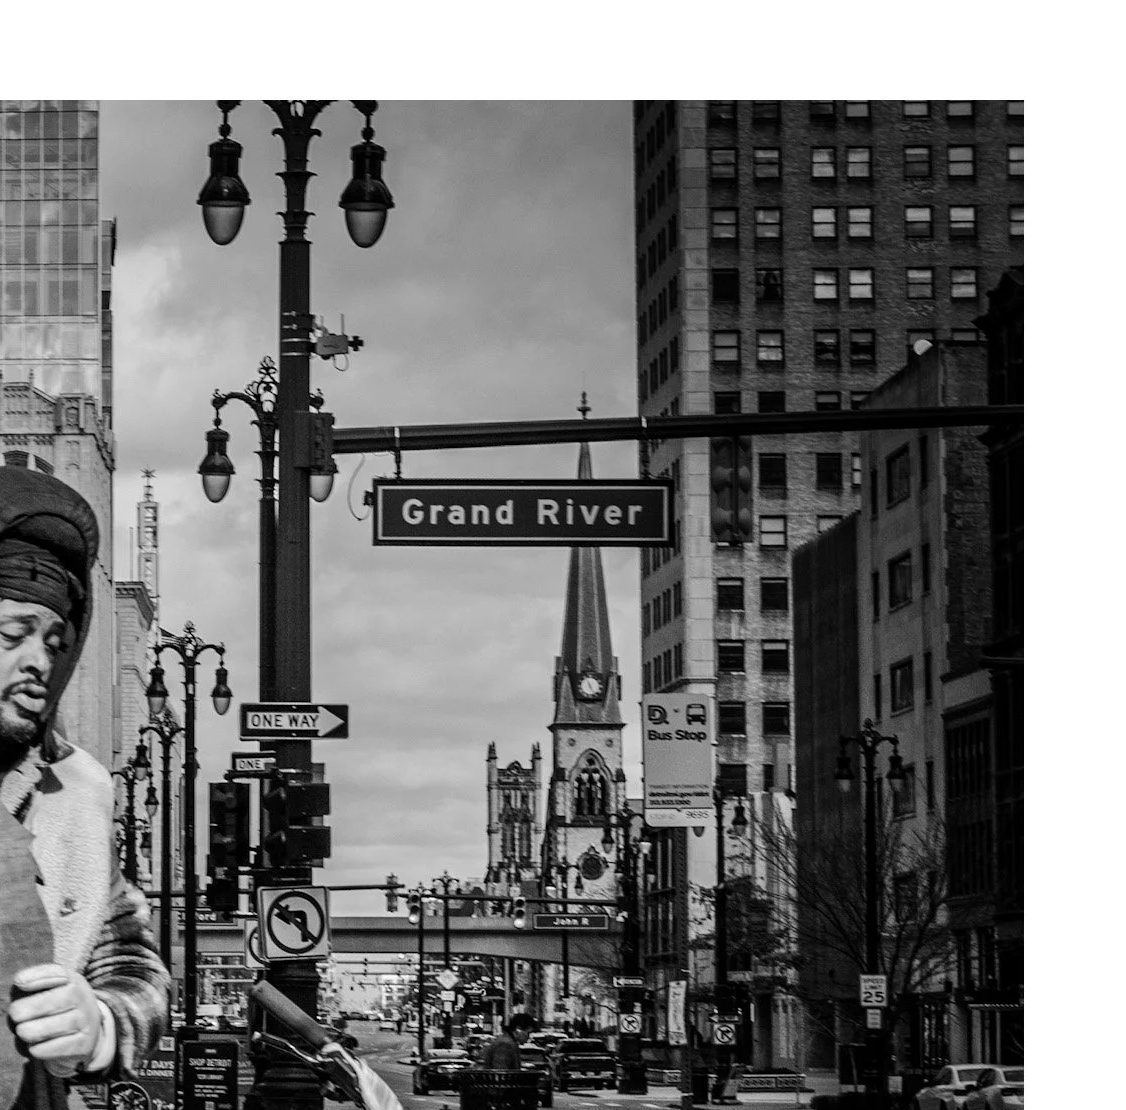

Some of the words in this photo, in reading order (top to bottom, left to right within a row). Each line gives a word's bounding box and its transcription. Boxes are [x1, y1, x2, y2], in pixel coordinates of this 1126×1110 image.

[401, 498, 514, 525] Grand
[537, 498, 643, 525] River
[251, 714, 283, 727] ONE
[288, 714, 319, 727] WAY
[648, 730, 673, 740] Bus
[675, 729, 707, 742] Stop
[239, 759, 262, 769] ONE
[553, 918, 579, 926] John
[582, 917, 590, 926] R
[864, 991, 885, 1003] 25
[151, 1060, 174, 1069] DAYS
